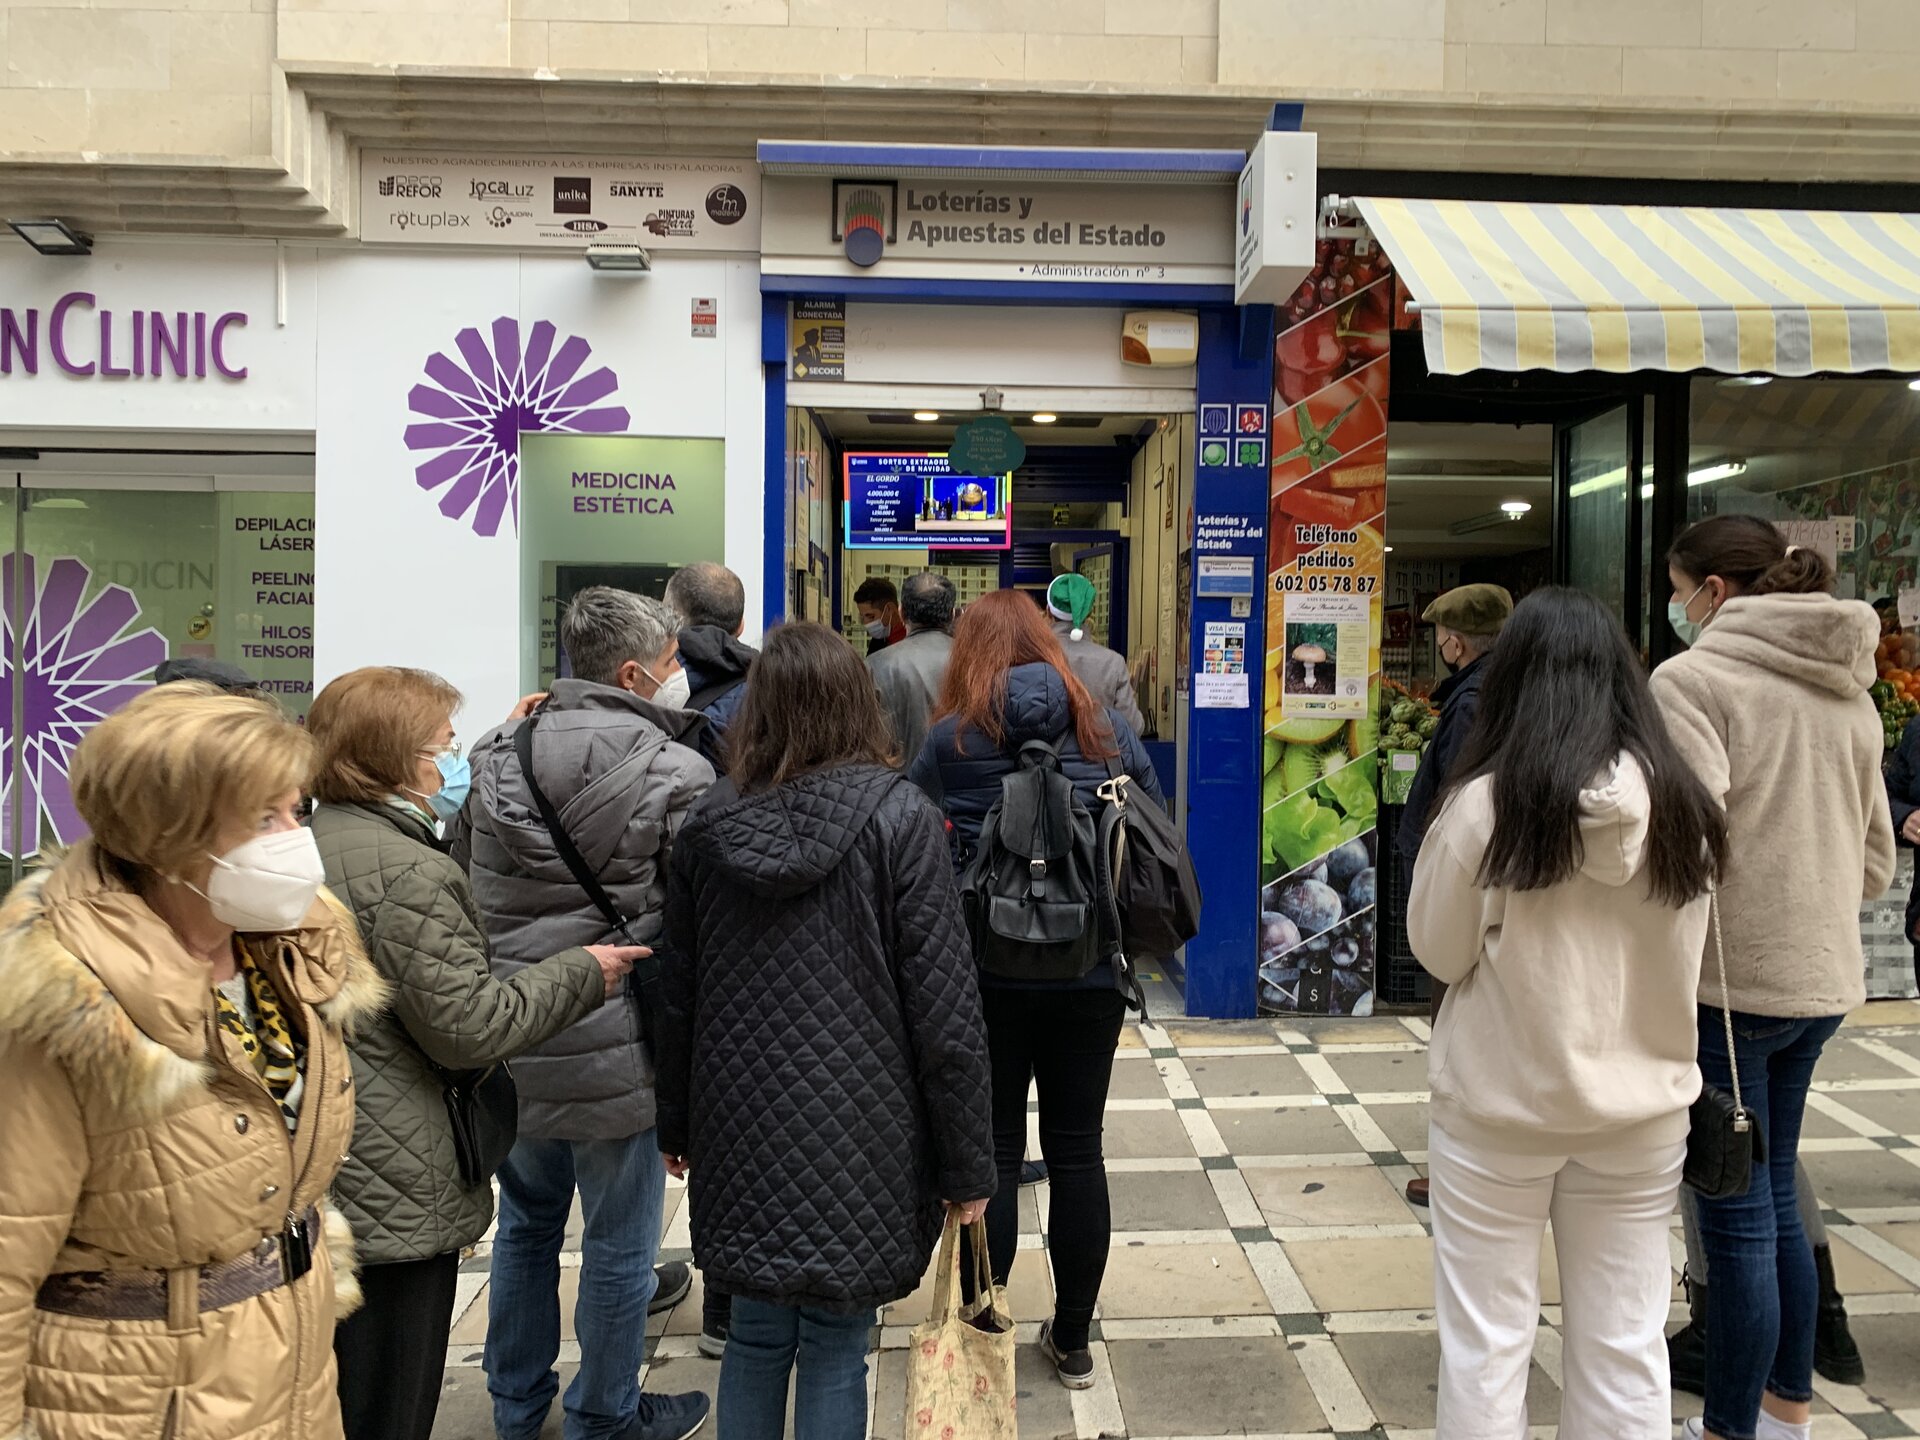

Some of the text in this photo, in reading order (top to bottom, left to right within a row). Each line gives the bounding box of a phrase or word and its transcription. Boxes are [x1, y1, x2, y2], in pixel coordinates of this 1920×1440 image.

[382, 156, 439, 165] NUESTRO
[442, 157, 547, 168] AGRADECIMIENTO
[562, 160, 586, 169] LAS
[588, 161, 650, 171] EMPRESAS
[653, 163, 743, 173] INSTALADORAS
[396, 185, 443, 198] REFOR
[557, 189, 587, 200] unika
[610, 186, 664, 198] SANYTE
[906, 189, 1033, 219] Loterías y
[389, 210, 470, 230] rotuplax
[658, 209, 695, 220] PINTURAS
[907, 220, 1166, 248] Apuestas del Estado
[1031, 263, 1129, 279] Administración
[1157, 266, 1165, 278] 3
[804, 301, 836, 309] ALARMA
[796, 311, 843, 319] CONECTADA
[808, 367, 843, 376] SECOEX
[878, 458, 907, 466] SORTEO
[571, 472, 676, 490] MEDICINA
[875, 475, 900, 483] GORDO
[573, 493, 674, 514] ESTÉTICA
[1197, 514, 1249, 528] Loterías y
[1197, 527, 1263, 539] Apuestas del
[1296, 525, 1358, 544] Teléfono
[260, 535, 314, 551] LÁSER
[1197, 539, 1233, 550] Estado
[1297, 550, 1354, 571] pedidos
[1275, 575, 1376, 593] 602 05 78 87
[256, 592, 314, 606] FACIAL
[261, 625, 312, 640] HILOS
[259, 680, 314, 694] OTERA
